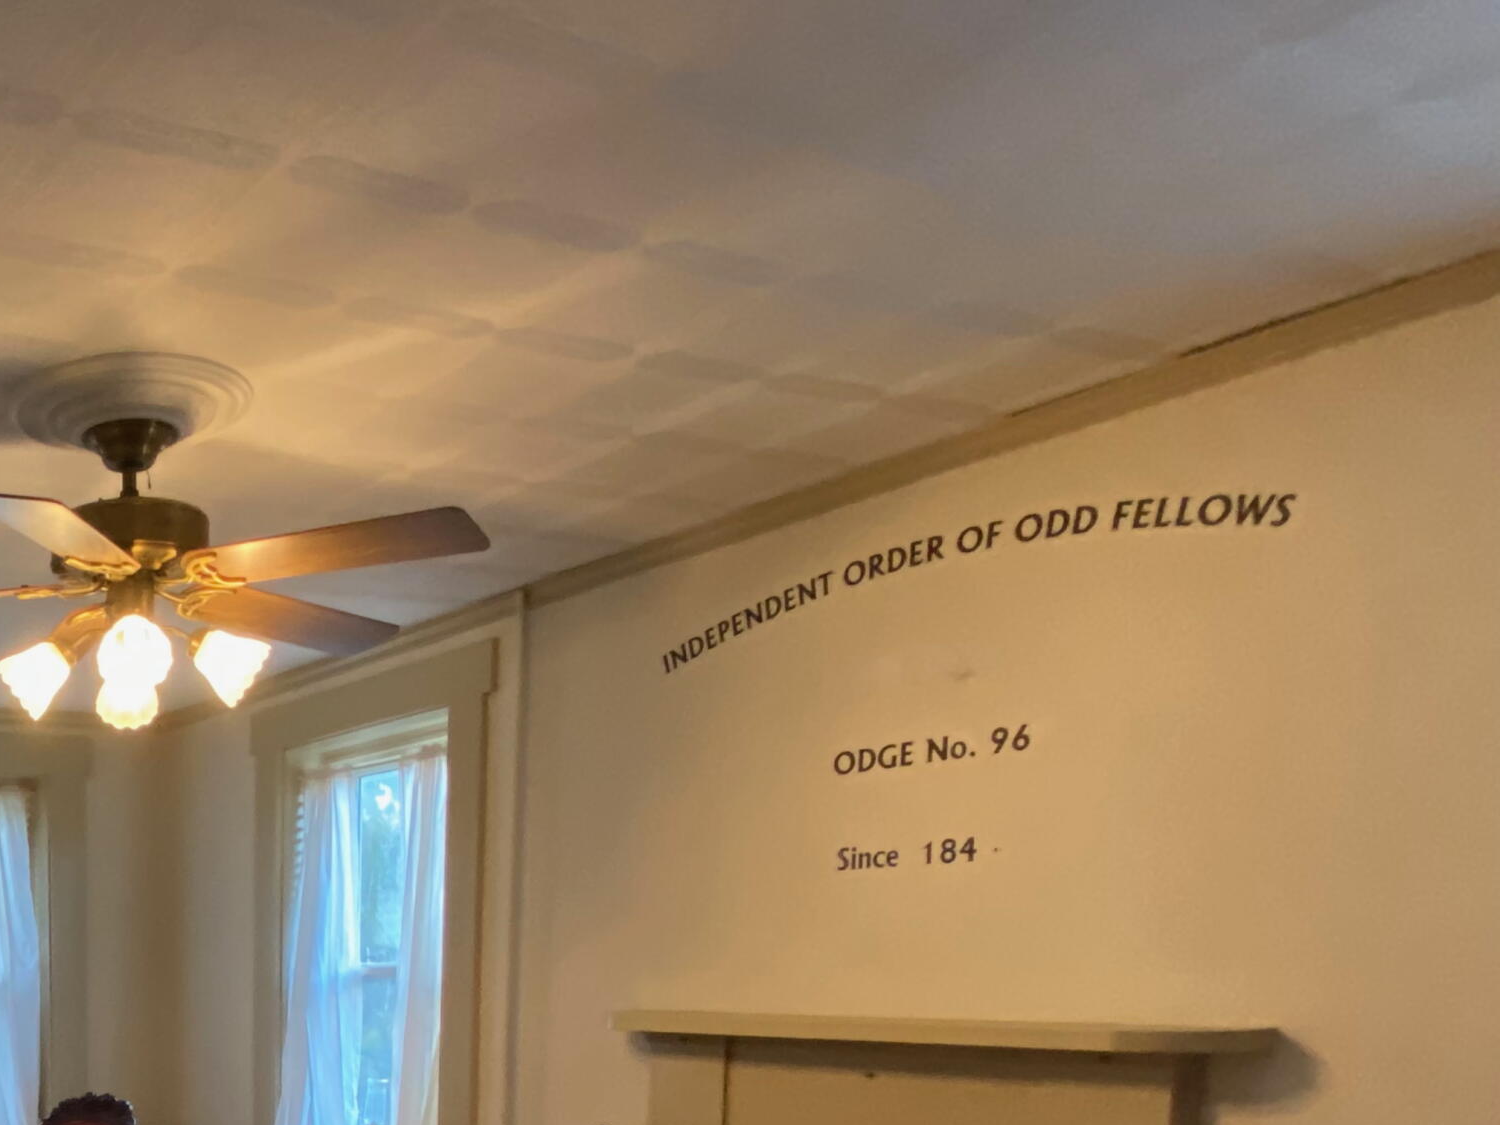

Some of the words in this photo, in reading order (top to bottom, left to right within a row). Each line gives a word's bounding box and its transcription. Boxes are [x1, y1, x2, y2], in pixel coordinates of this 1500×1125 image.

[661, 569, 834, 675] INDEPENDENT
[842, 534, 946, 588] ORDER
[955, 519, 1005, 555] OF
[1013, 504, 1100, 544] ODD
[1110, 491, 1299, 533] FELLOWS
[925, 734, 977, 765] No.
[989, 722, 1032, 756] 96
[836, 845, 900, 873] Since
